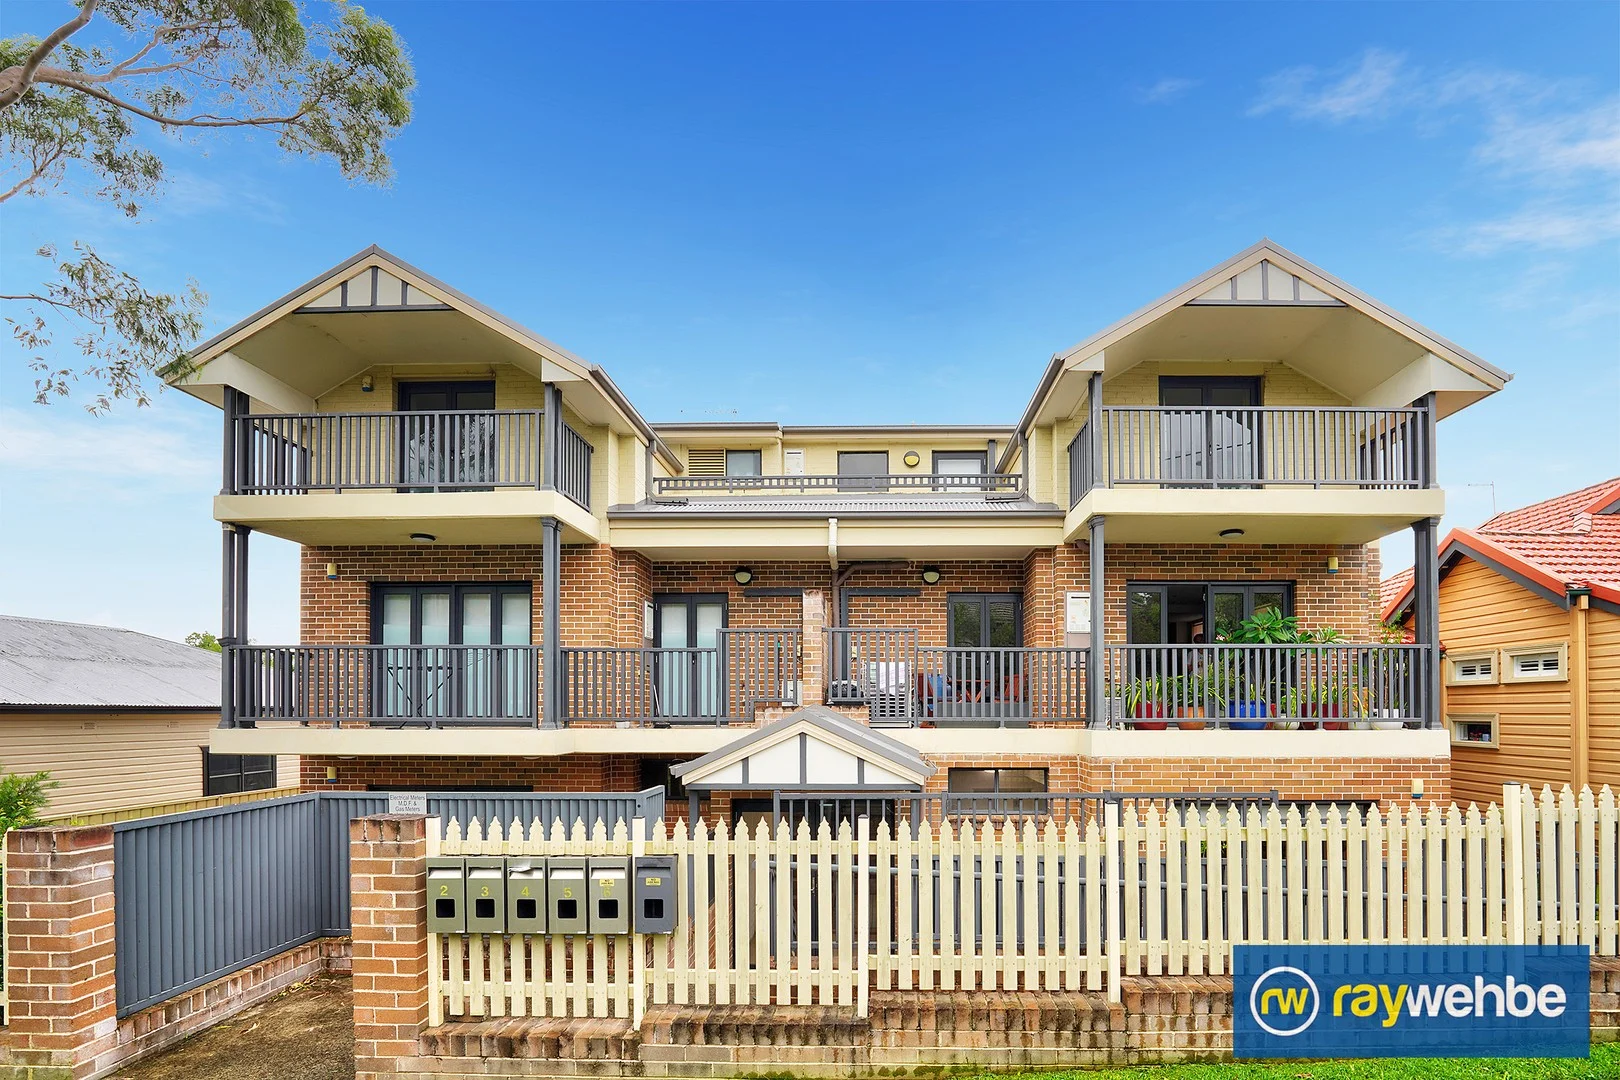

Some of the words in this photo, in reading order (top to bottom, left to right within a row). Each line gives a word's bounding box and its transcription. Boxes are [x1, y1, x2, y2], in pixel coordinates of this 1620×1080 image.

[440, 885, 448, 896] 2
[481, 886, 489, 897] 3
[521, 886, 530, 897] 4
[564, 888, 572, 898] 5
[603, 886, 611, 897] 6
